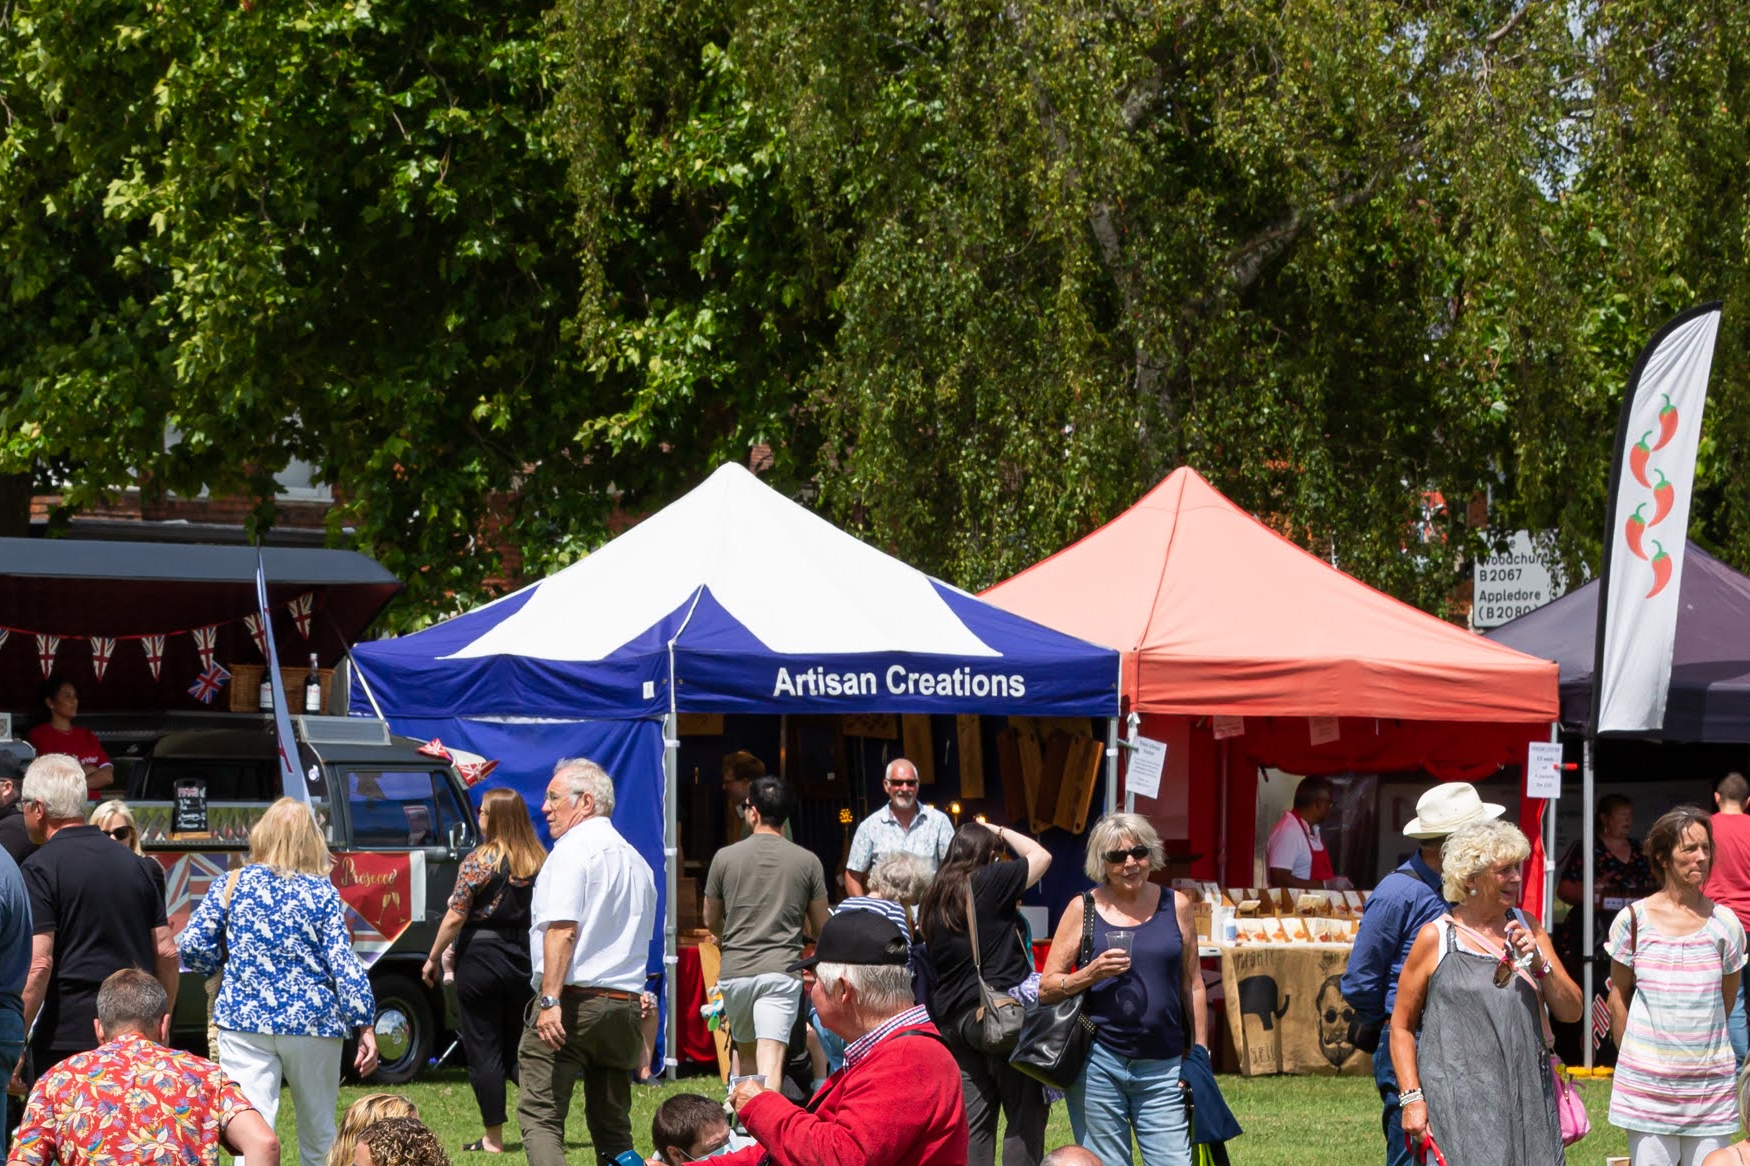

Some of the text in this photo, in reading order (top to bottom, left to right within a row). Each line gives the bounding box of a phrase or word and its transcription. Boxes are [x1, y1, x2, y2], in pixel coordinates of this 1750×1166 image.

[1479, 568, 1522, 582] B2067
[1479, 588, 1541, 604] Appledore
[773, 664, 1026, 698] Artisan Creations
[340, 856, 398, 888] Prosecco
